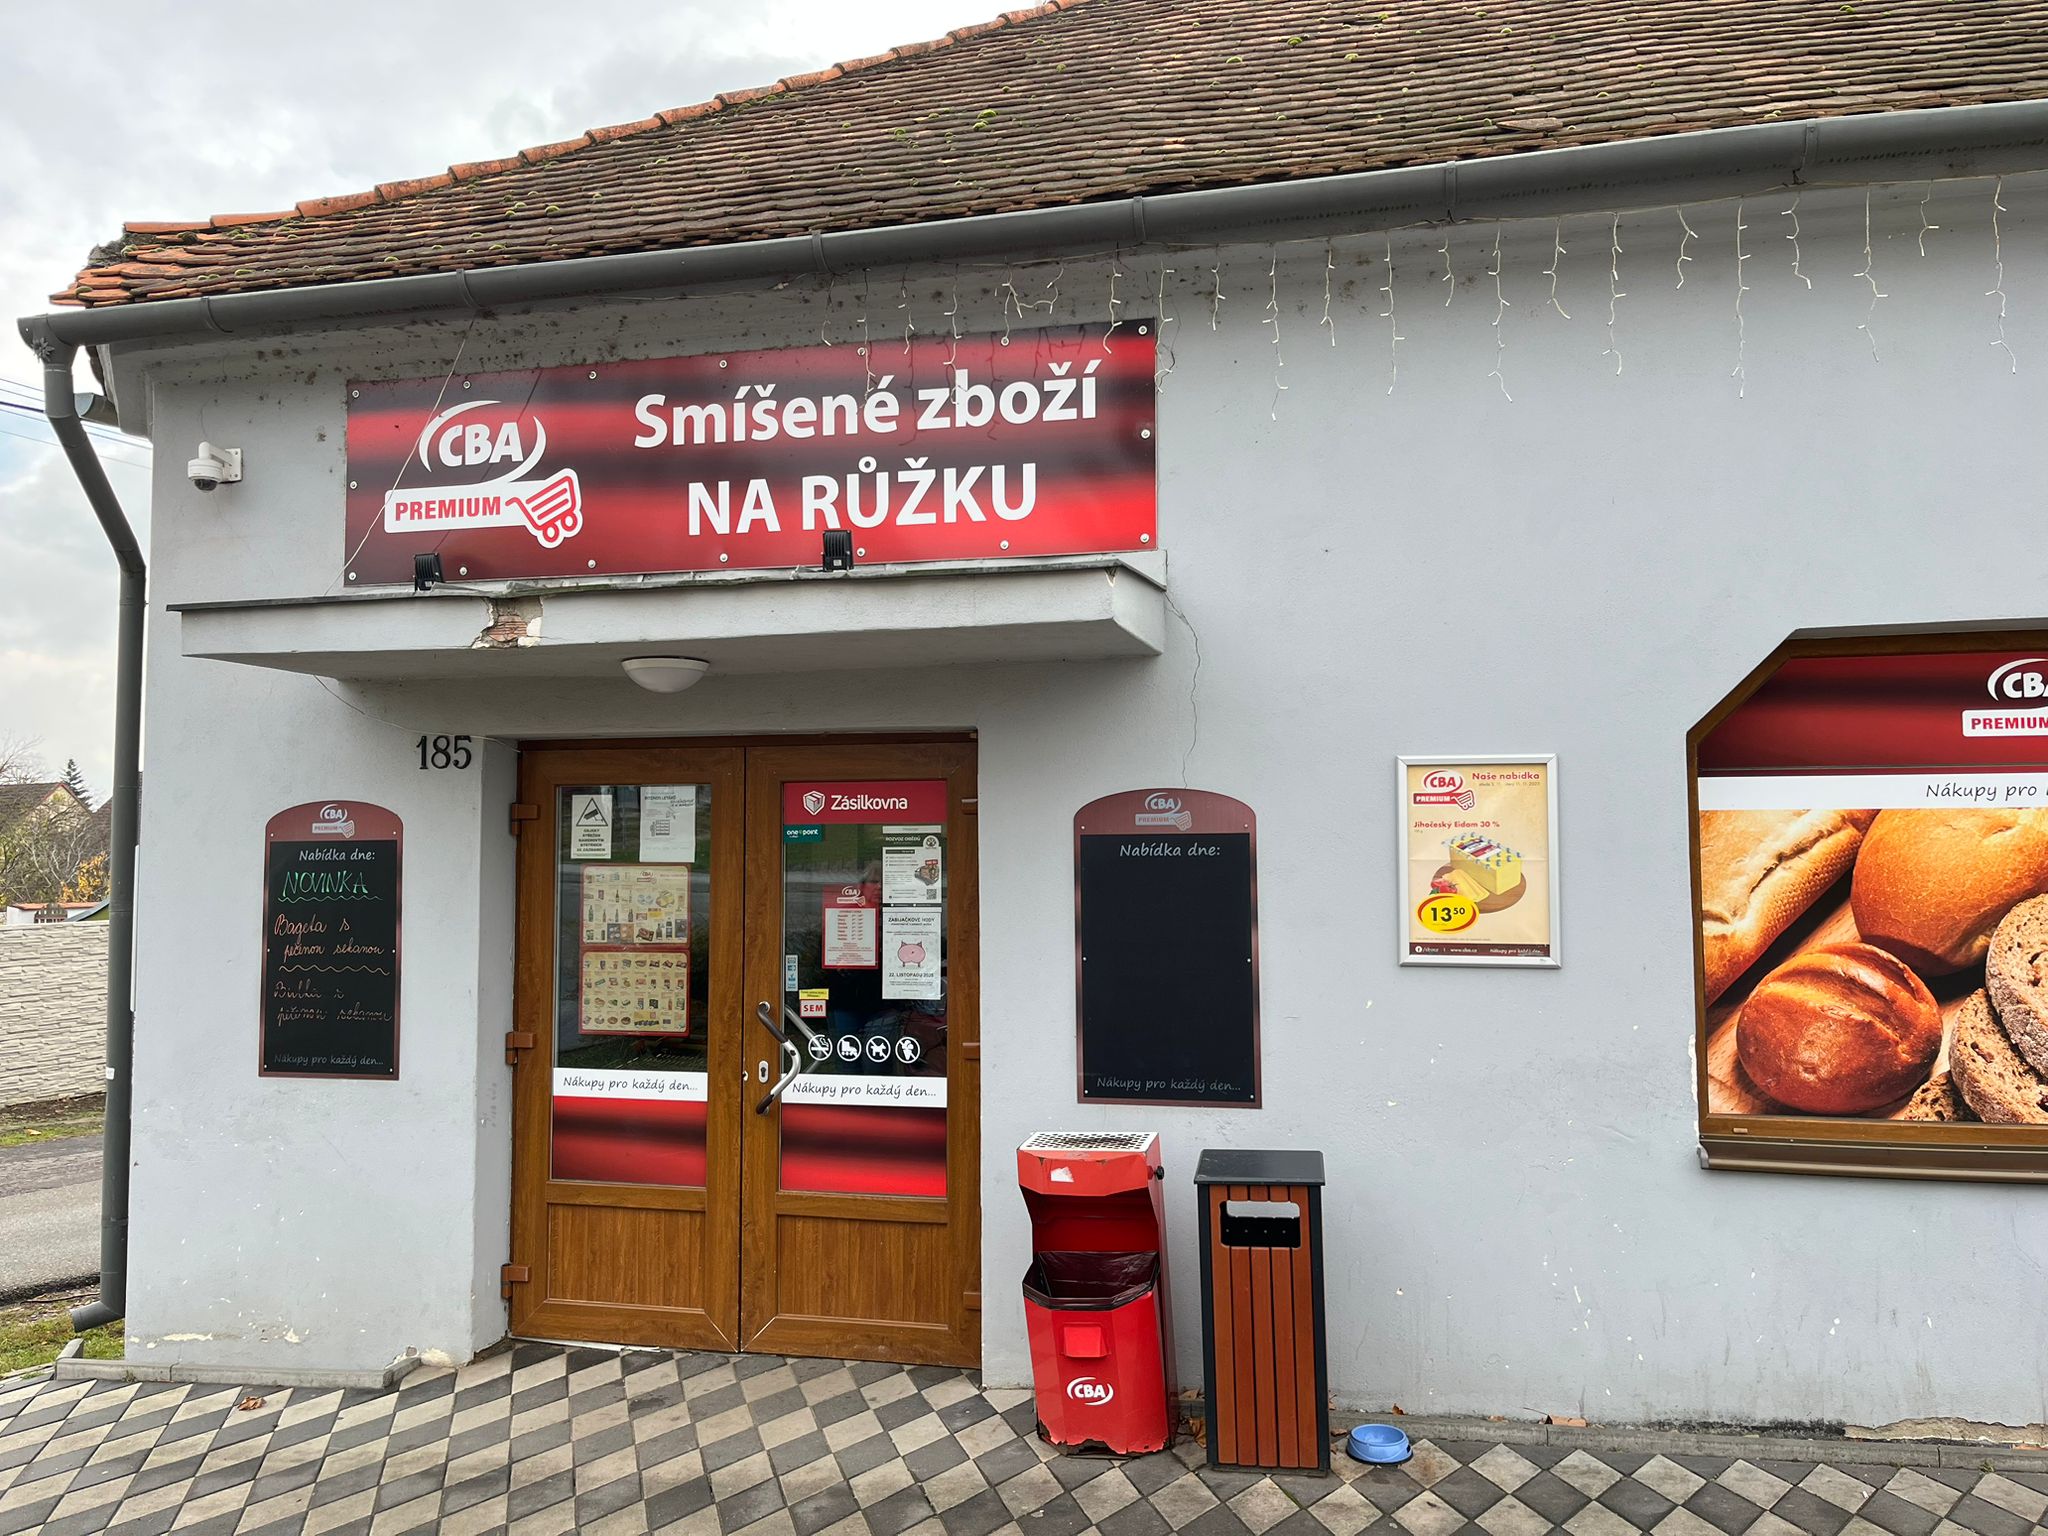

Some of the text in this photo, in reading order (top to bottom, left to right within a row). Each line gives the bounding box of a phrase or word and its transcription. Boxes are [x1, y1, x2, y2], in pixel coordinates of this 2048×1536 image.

[634, 359, 1102, 447] Smíšené zboží
[439, 421, 524, 467] CBA
[688, 456, 1036, 535] NA RŮŽKU
[395, 496, 501, 521] PREMIUM
[2003, 672, 2048, 699] CB
[1971, 717, 2048, 730] PREMIUM
[416, 735, 473, 770] 185
[1430, 776, 1457, 788] CBA
[1472, 772, 1497, 780] Naše
[1415, 795, 1451, 803] PREMIUM
[1926, 782, 2037, 802] Nákupy pro
[831, 794, 908, 811] Zásilkovna
[1150, 798, 1176, 810] CBA
[323, 809, 343, 820] CBA
[299, 848, 375, 861] Nabídka dne:
[1119, 842, 1221, 857] Nabídka dne:
[282, 870, 369, 897] NOVINKA
[274, 913, 350, 944] Bageta s
[803, 1004, 824, 1012] SEM
[274, 1053, 308, 1067] Nákupy
[311, 1055, 327, 1066] pro
[330, 1054, 357, 1067] každý
[563, 1076, 698, 1093] Nákupy pro každý den...
[792, 1082, 937, 1099] Nákupy pro každý den...
[1096, 1076, 1241, 1093] Nákupy pro každý den...
[1074, 1384, 1106, 1398] CBA
